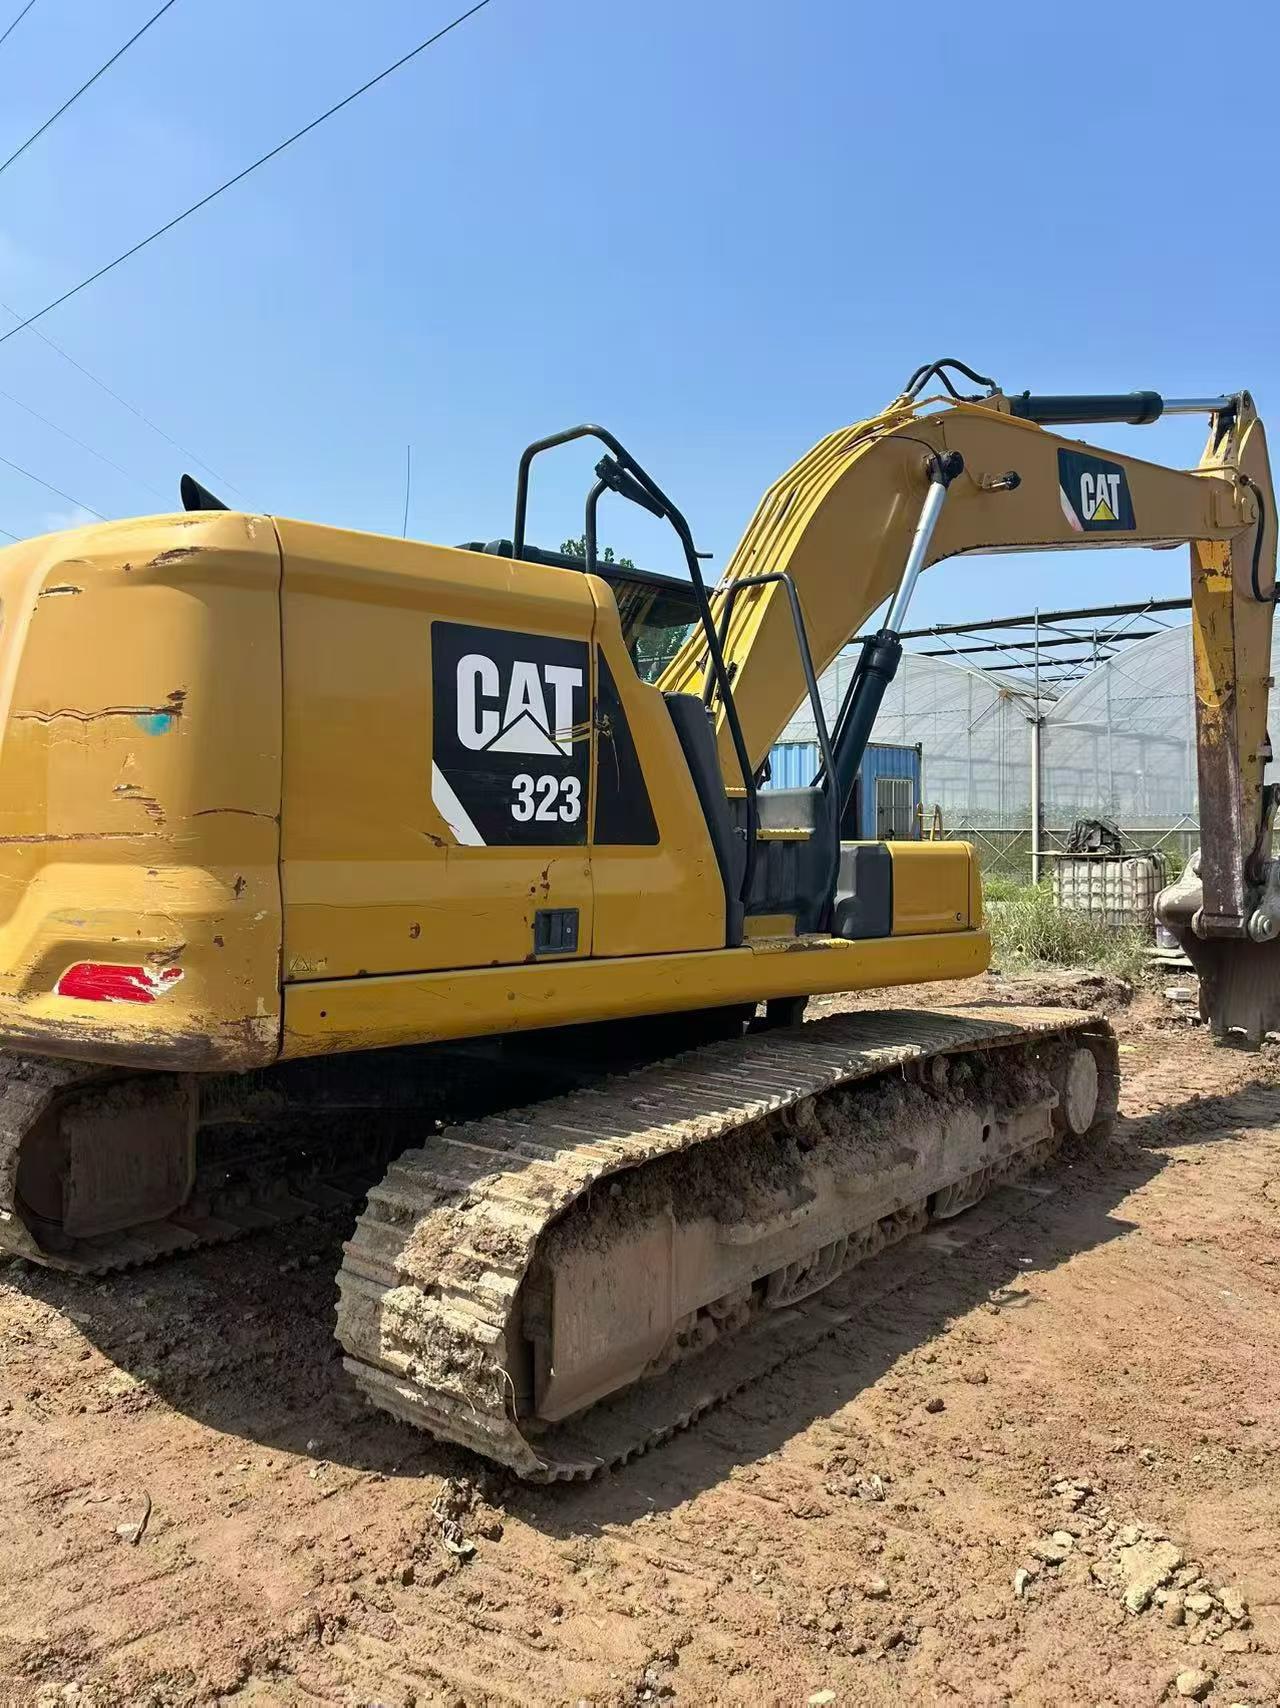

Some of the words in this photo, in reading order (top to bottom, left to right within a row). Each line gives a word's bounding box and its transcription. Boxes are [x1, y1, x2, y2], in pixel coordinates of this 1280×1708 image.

[1080, 472, 1120, 520] CAT
[456, 653, 583, 756] CAT
[511, 773, 581, 822] 323
